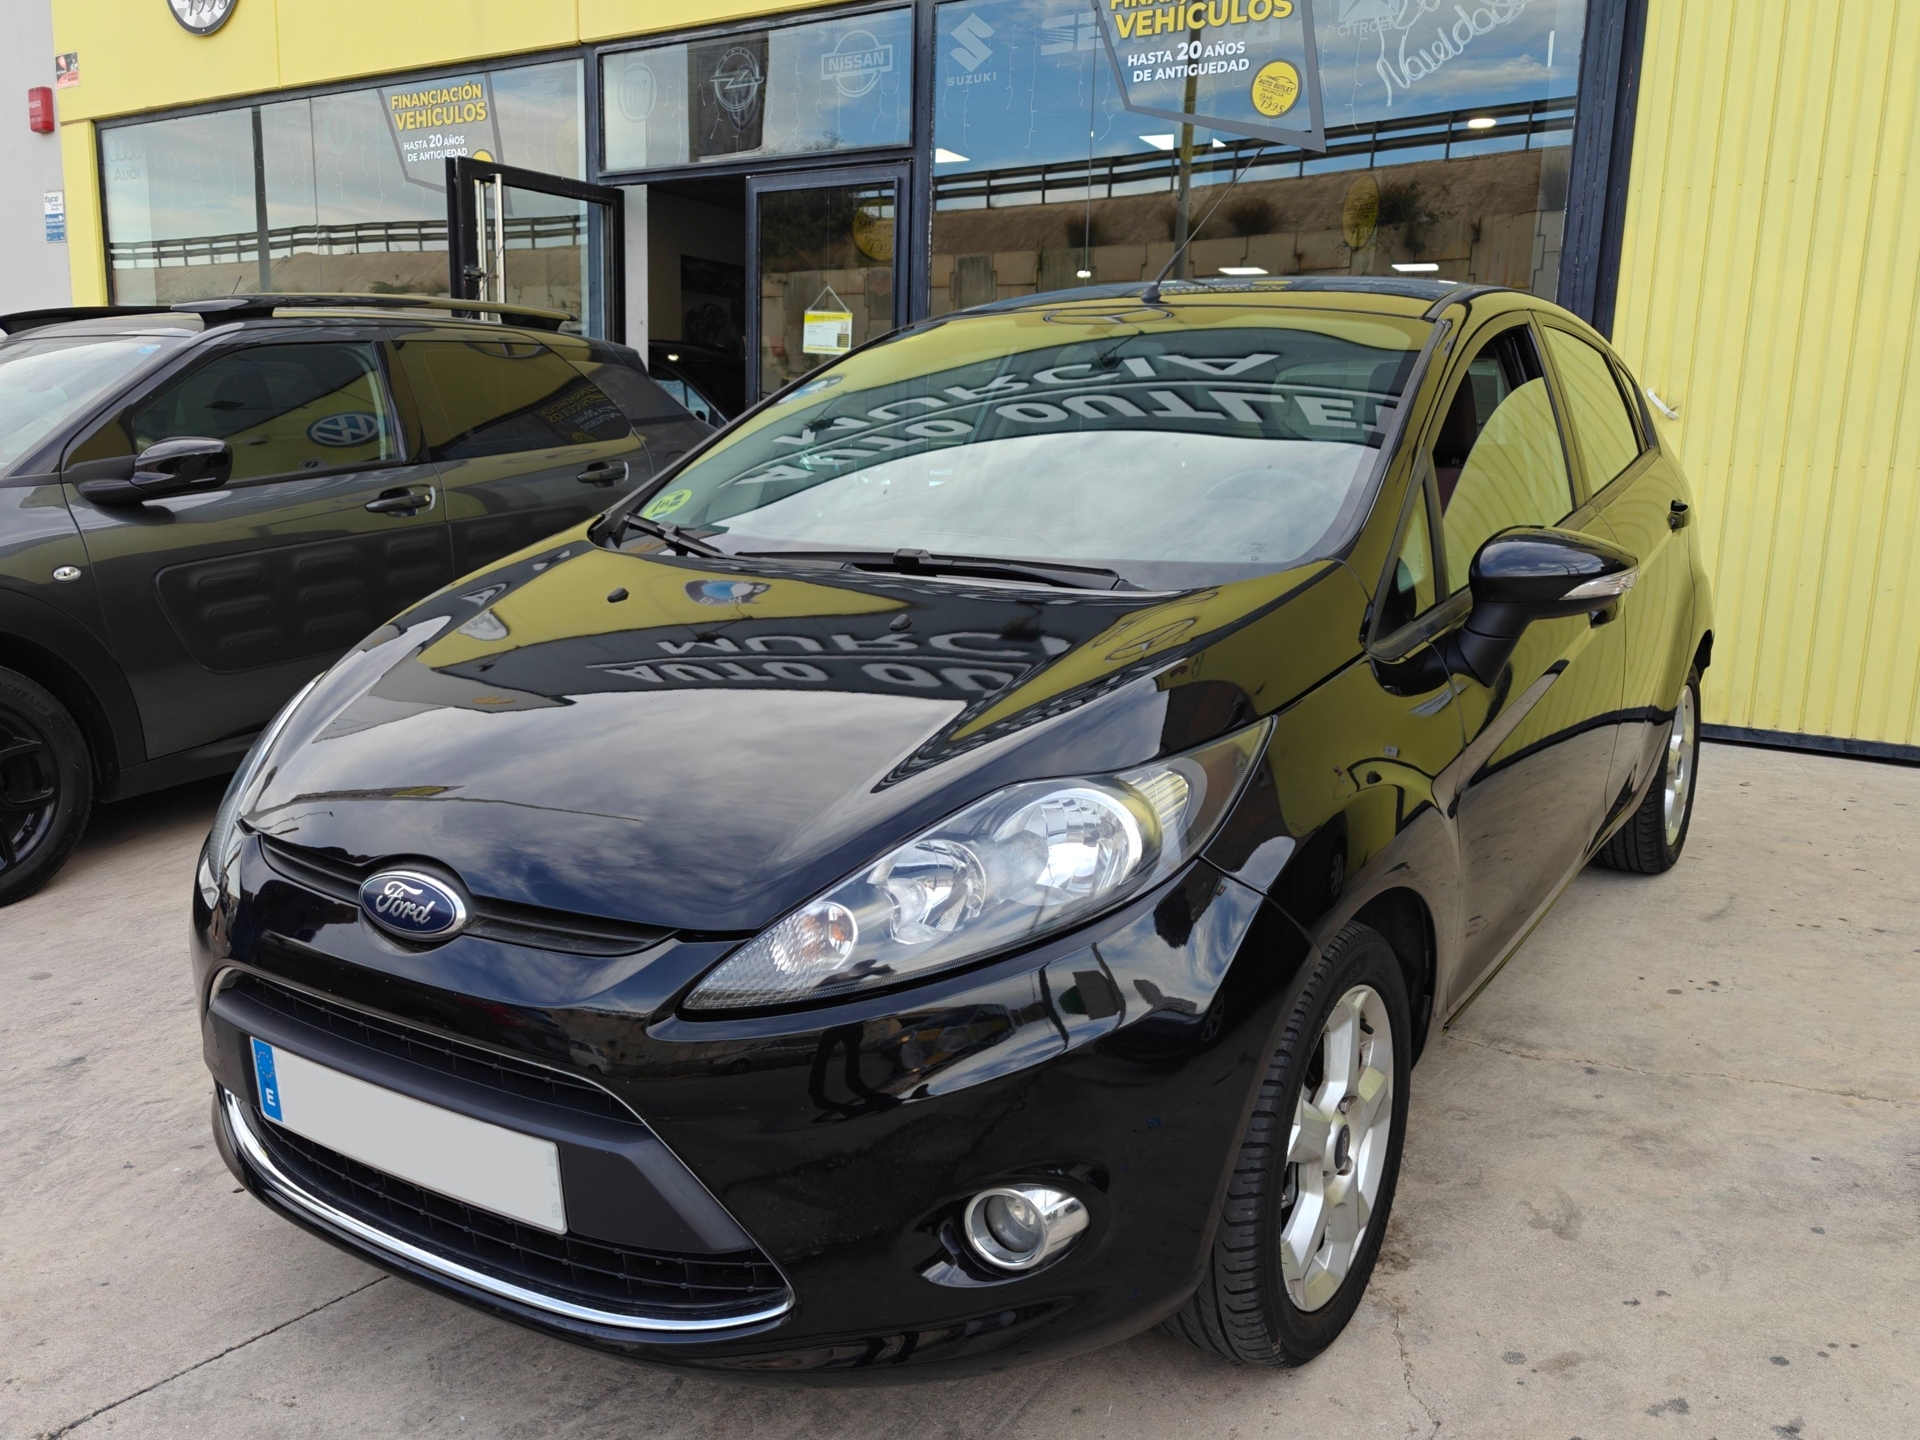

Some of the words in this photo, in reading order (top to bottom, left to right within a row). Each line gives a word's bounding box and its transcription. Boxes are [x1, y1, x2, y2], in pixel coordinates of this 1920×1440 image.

[1114, 0, 1294, 39] VEHÍCULOS
[829, 50, 884, 72] NISSAN
[1127, 50, 1173, 67] HASTA
[1176, 41, 1203, 61] 20
[1204, 41, 1246, 58] AÑOS
[947, 72, 997, 86] SUZUKI
[1133, 69, 1152, 82] DE
[1155, 58, 1250, 80] ANTIGUEDAD
[391, 81, 482, 110] FINANCIACIÓN
[1258, 79, 1273, 87] AUTO
[1273, 83, 1294, 93] OUTLET
[394, 101, 488, 131] VEHÍCULOS
[1260, 100, 1285, 114] 1998
[404, 140, 428, 151] HASTA
[428, 134, 443, 148] 20
[443, 135, 465, 147] AÑOS
[407, 153, 418, 162] DE
[420, 147, 468, 161] ANTIGUEDAD
[114, 166, 140, 181] Audi
[376, 881, 436, 924] Ford
[265, 1087, 276, 1107] E
